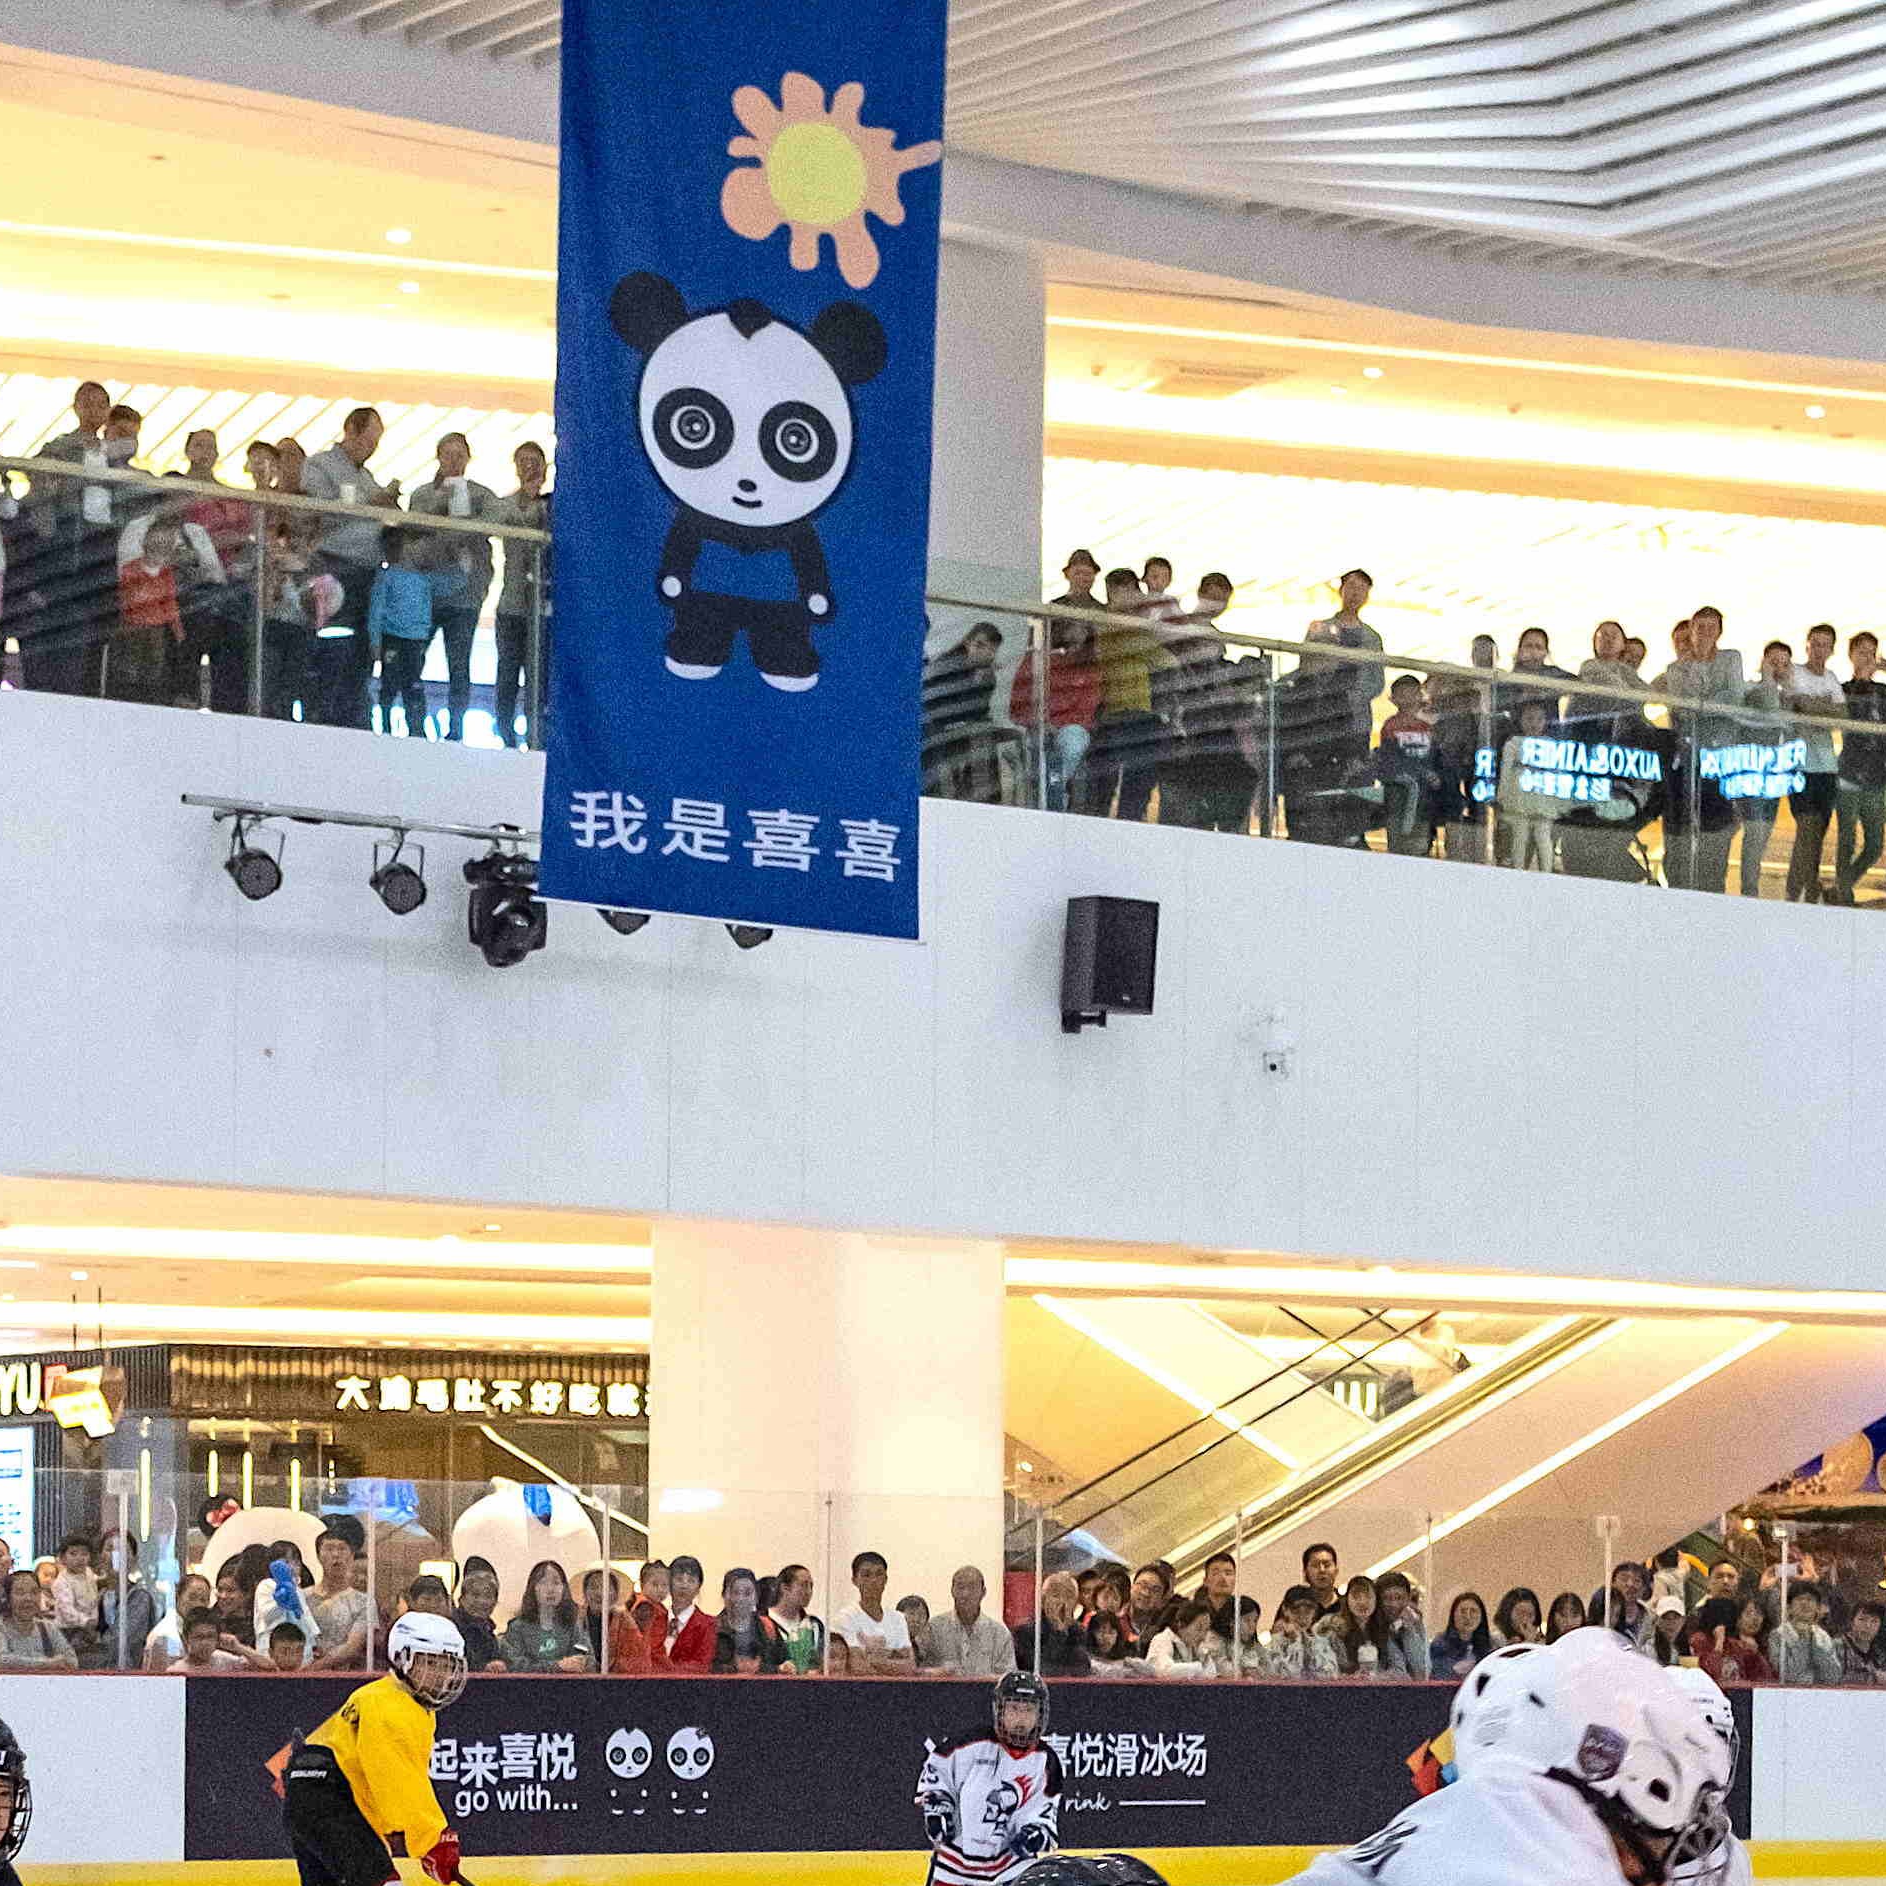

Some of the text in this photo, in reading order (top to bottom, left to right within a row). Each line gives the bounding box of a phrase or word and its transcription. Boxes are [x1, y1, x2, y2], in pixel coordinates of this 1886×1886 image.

[570, 789, 901, 883] 我是喜喜
[454, 1783, 579, 1818] go with...
[1064, 1790, 1112, 1814] rink
